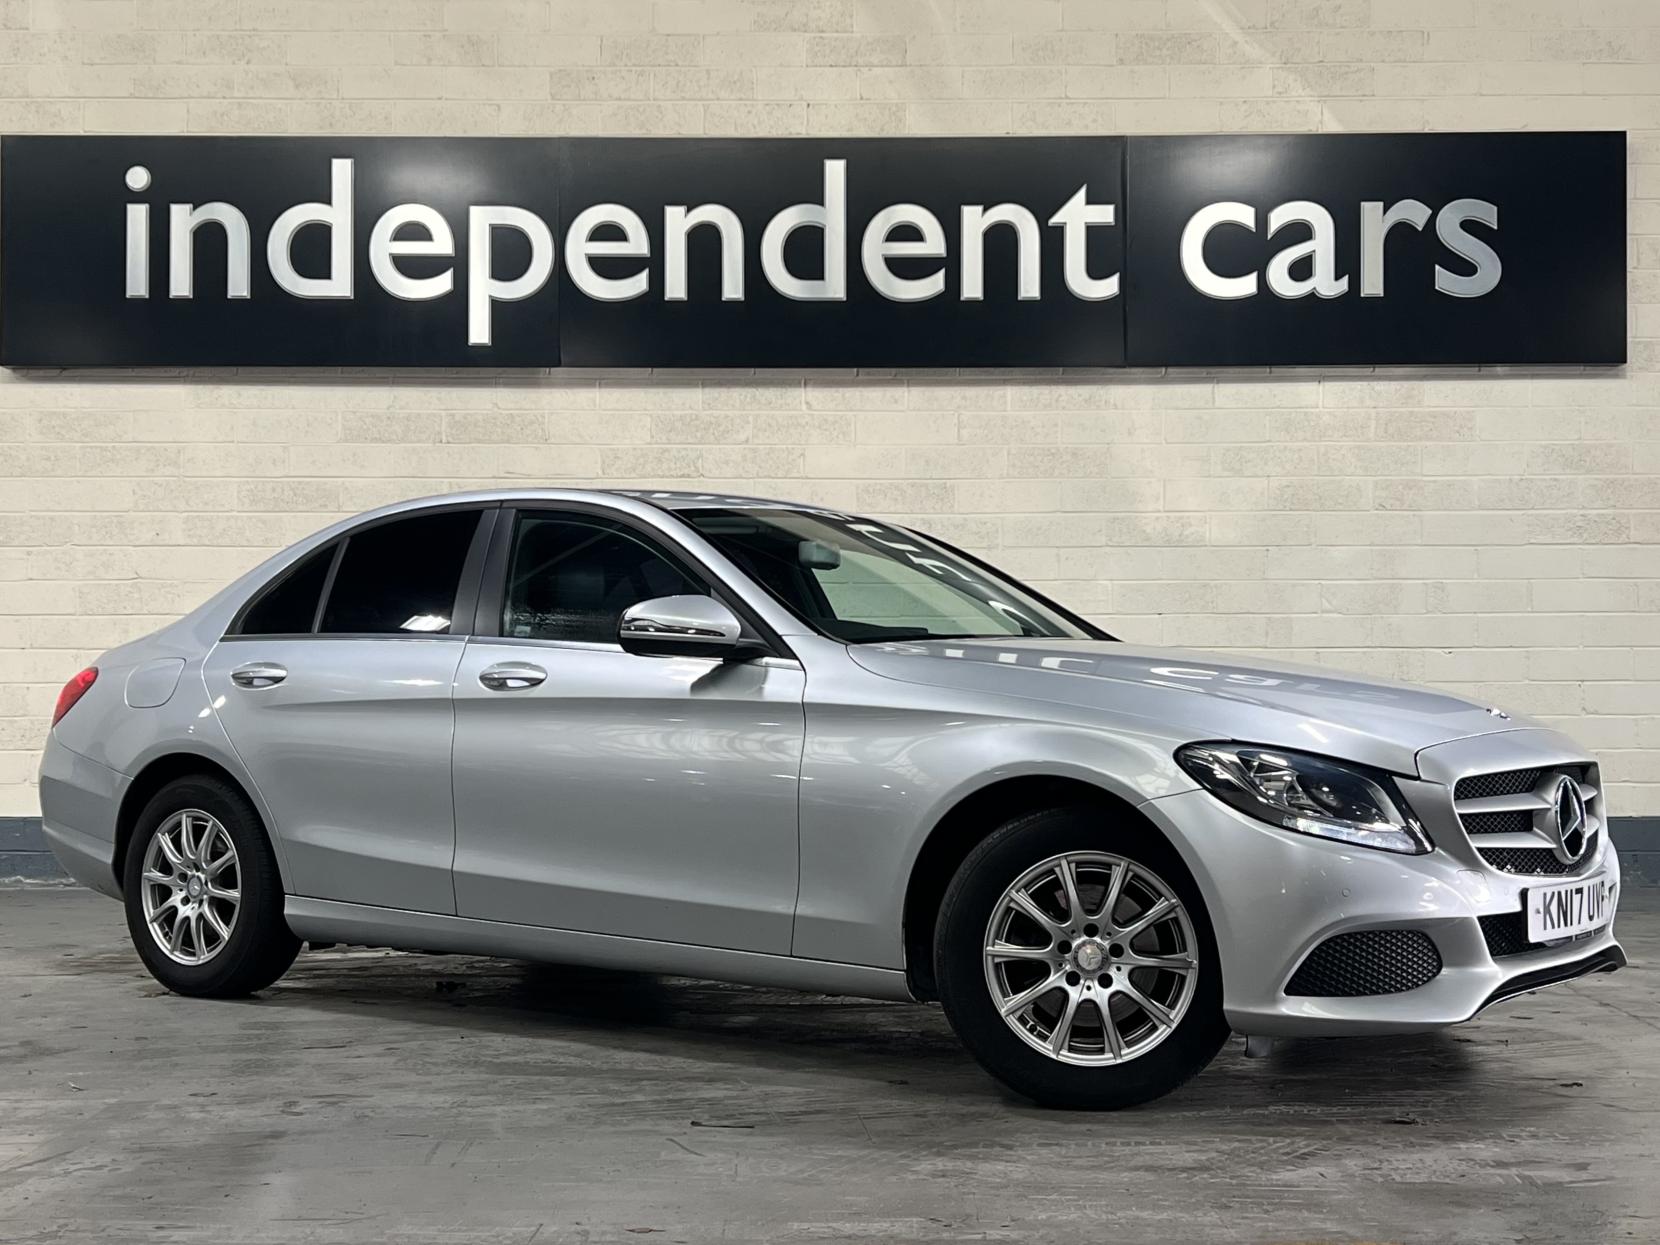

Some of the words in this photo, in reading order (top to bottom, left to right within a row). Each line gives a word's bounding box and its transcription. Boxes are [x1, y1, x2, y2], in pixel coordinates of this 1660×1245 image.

[125, 158, 1120, 346] independent
[1180, 198, 1502, 300] cars
[1543, 886, 1584, 930] KN17
